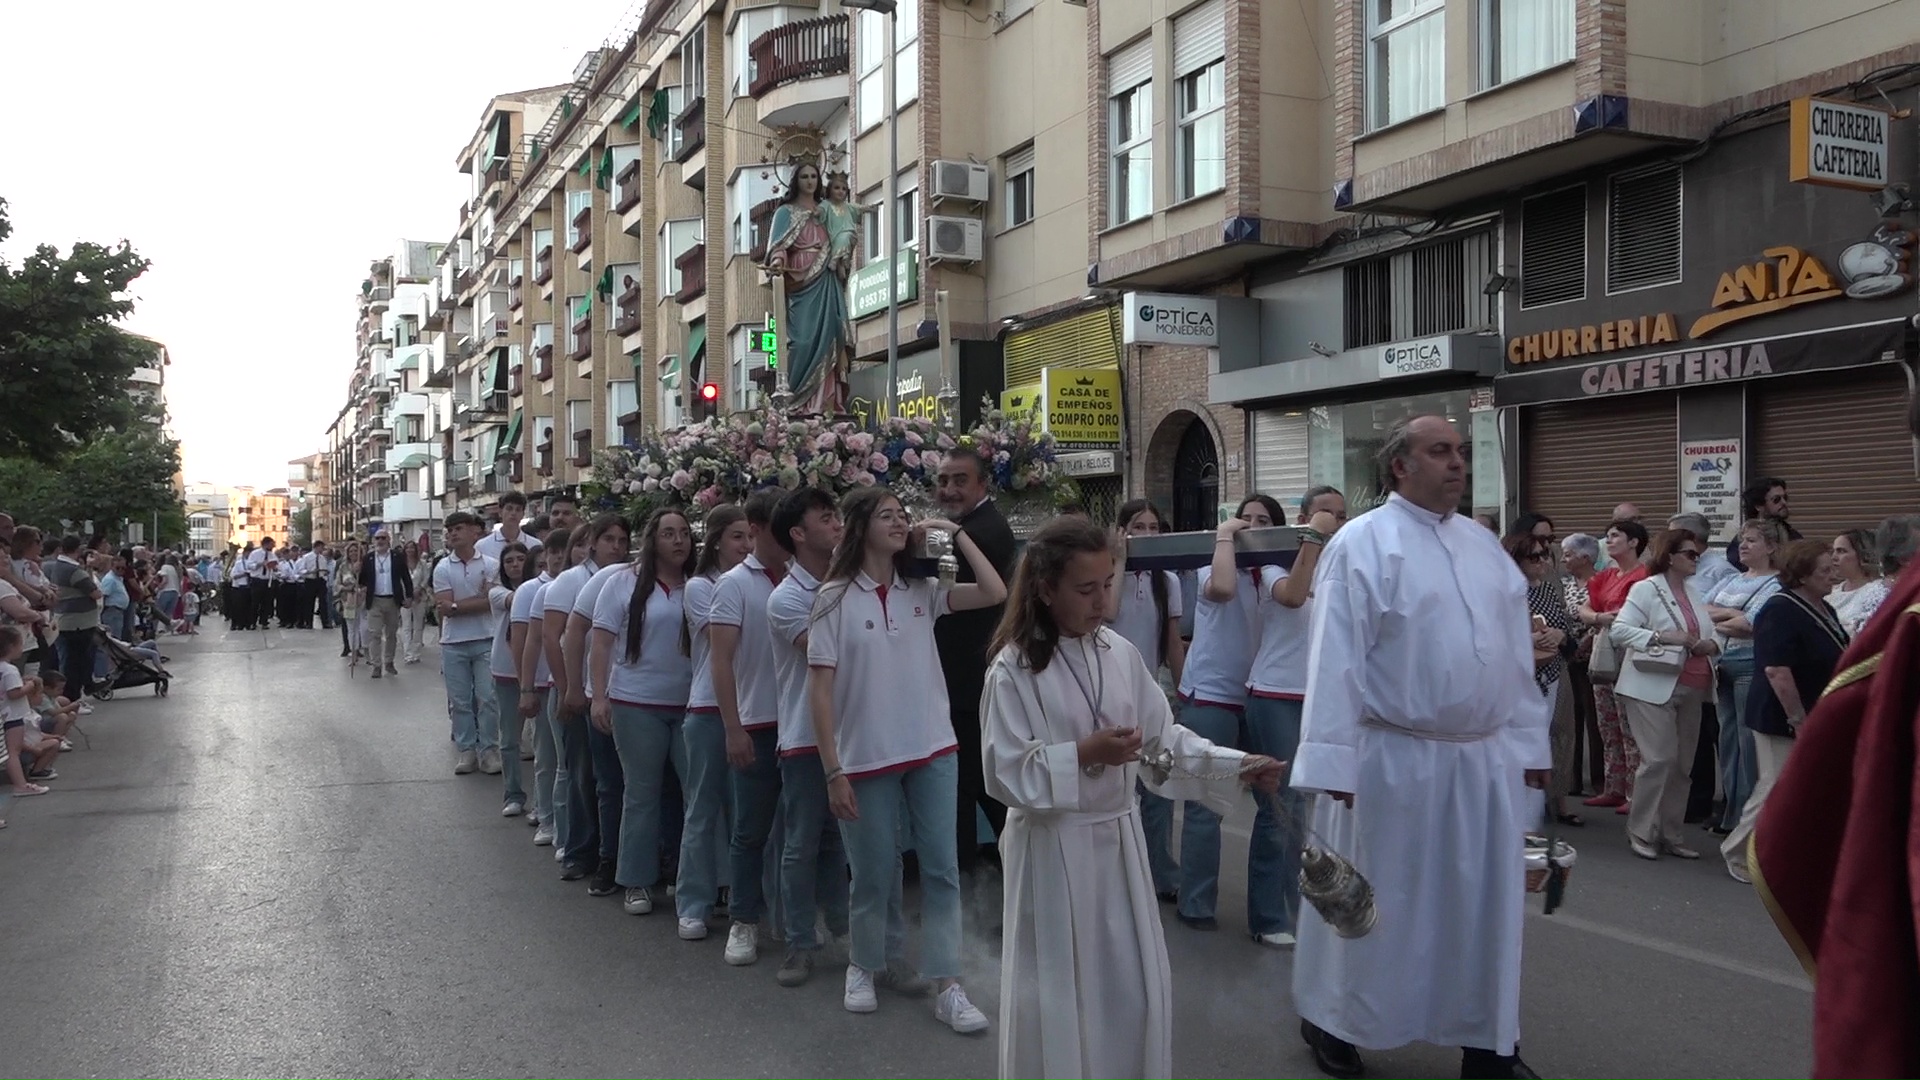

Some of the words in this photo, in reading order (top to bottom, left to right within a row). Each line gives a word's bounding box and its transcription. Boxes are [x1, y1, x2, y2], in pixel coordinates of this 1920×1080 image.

[1812, 106, 1883, 144] CHURRERIA
[1814, 143, 1882, 180] CAFETERIA
[1155, 324, 1215, 336] MONEDERO
[1507, 313, 1677, 365] CHURRERIA
[1396, 358, 1442, 373] MONEDERO
[1581, 344, 1773, 395] CAFETERIA
[1060, 387, 1091, 397] CASA
[1095, 388, 1110, 397] DE
[1057, 399, 1113, 410] EMPEÑOS
[1050, 413, 1094, 426] COMPRO
[1098, 413, 1119, 426] ORO
[1684, 444, 1737, 456] CHURRERIA
